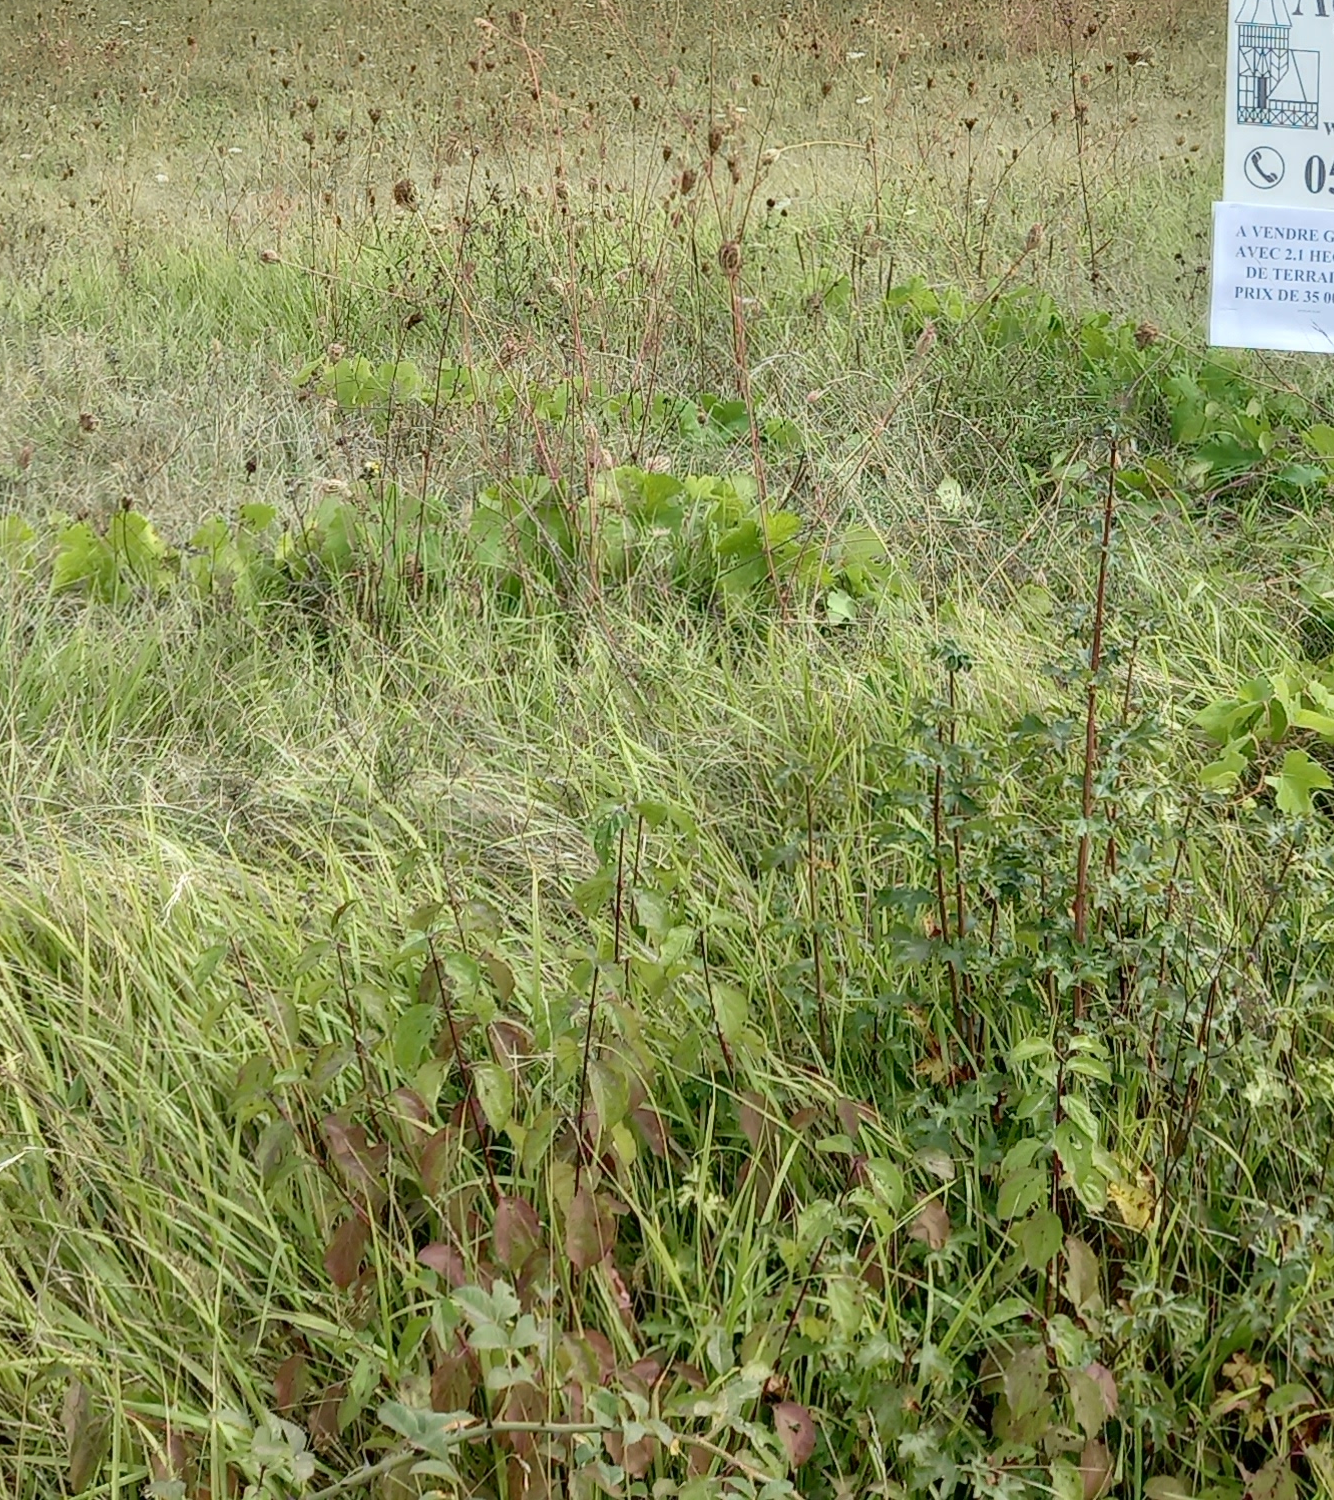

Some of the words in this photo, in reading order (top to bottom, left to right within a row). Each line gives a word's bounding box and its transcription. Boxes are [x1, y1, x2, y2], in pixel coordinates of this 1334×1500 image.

[1235, 226, 1247, 238] A
[1252, 226, 1318, 242] VENDRE
[1235, 246, 1281, 260] AVEC
[1285, 248, 1303, 261] 2.1
[1246, 266, 1268, 279] DE
[1235, 286, 1273, 300] PRIX
[1278, 289, 1299, 302] DE
[1303, 291, 1319, 303] 35
